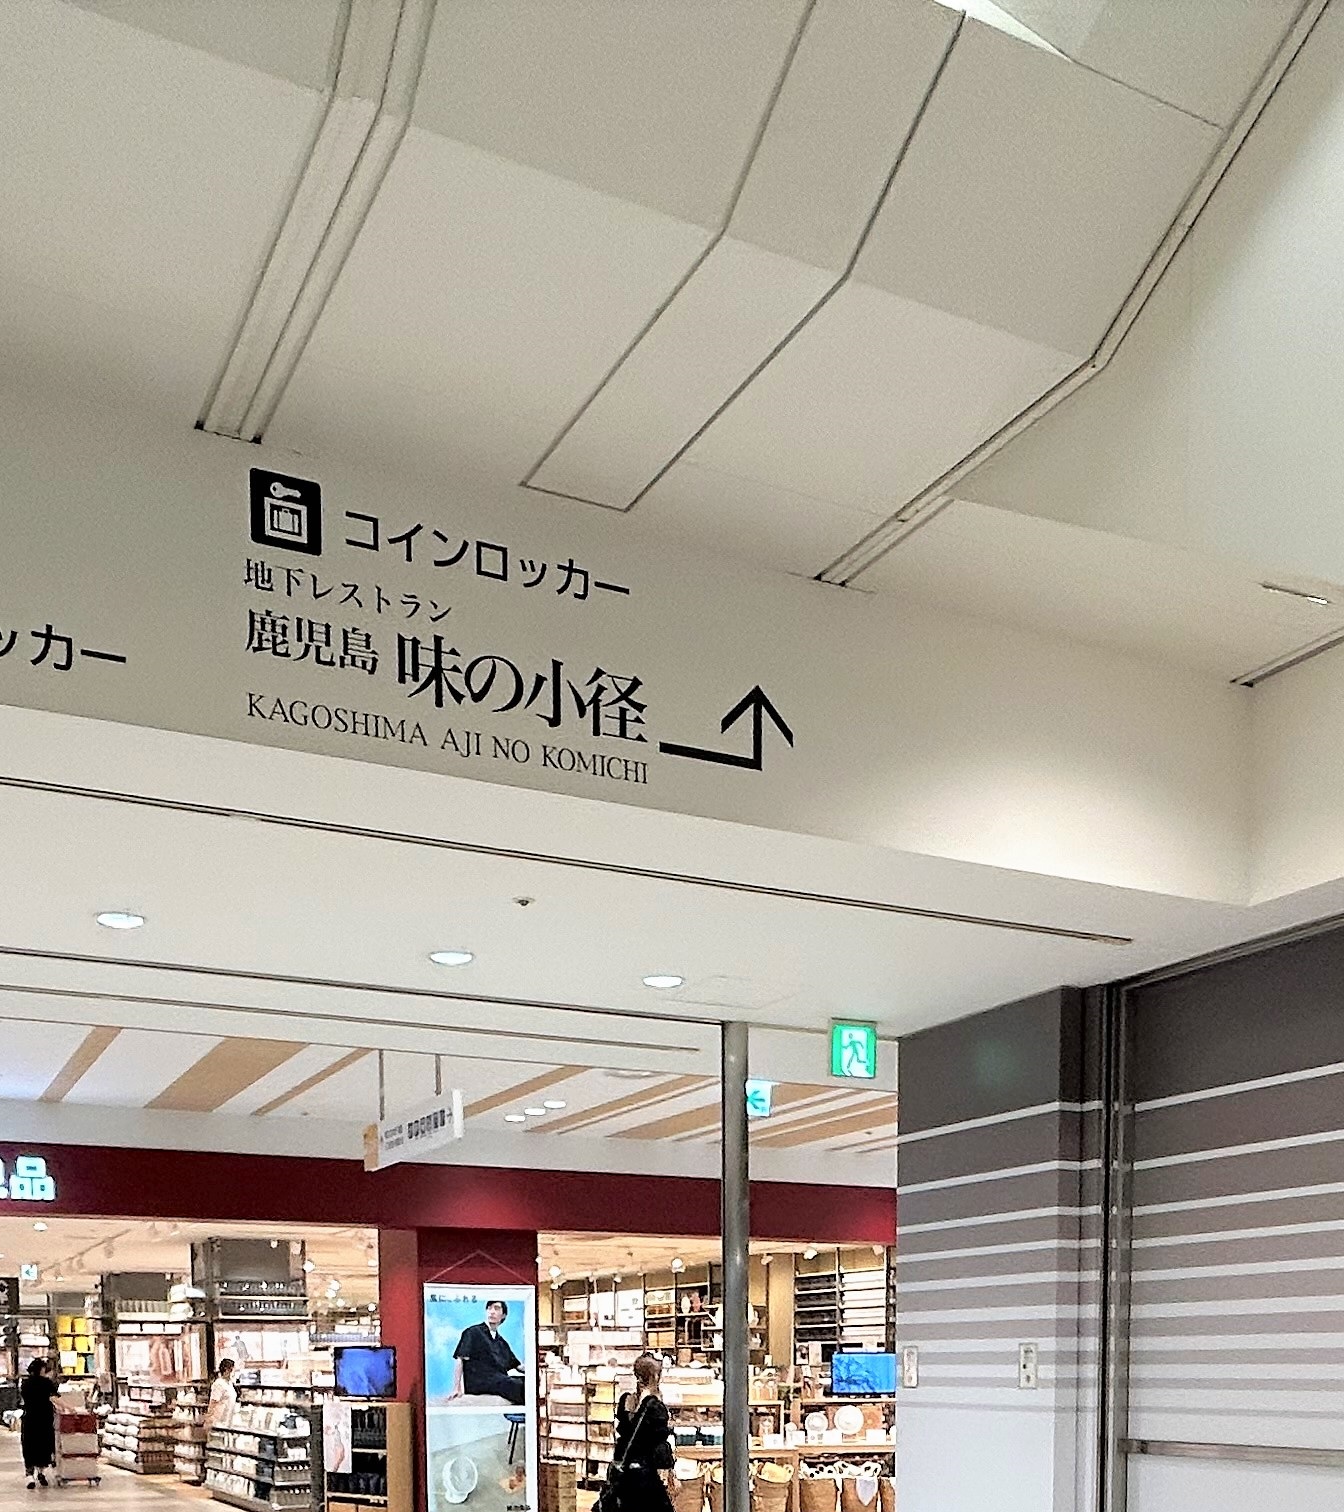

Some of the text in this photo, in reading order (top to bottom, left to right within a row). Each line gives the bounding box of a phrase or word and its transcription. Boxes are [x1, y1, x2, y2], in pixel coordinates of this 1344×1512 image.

[244, 557, 453, 624] 地下レストラン
[344, 510, 631, 601] コインロッカー
[245, 608, 650, 744] 鹿児島 味の小径
[246, 692, 649, 785] KAGOSHIMA AJI NO KOMICHI
